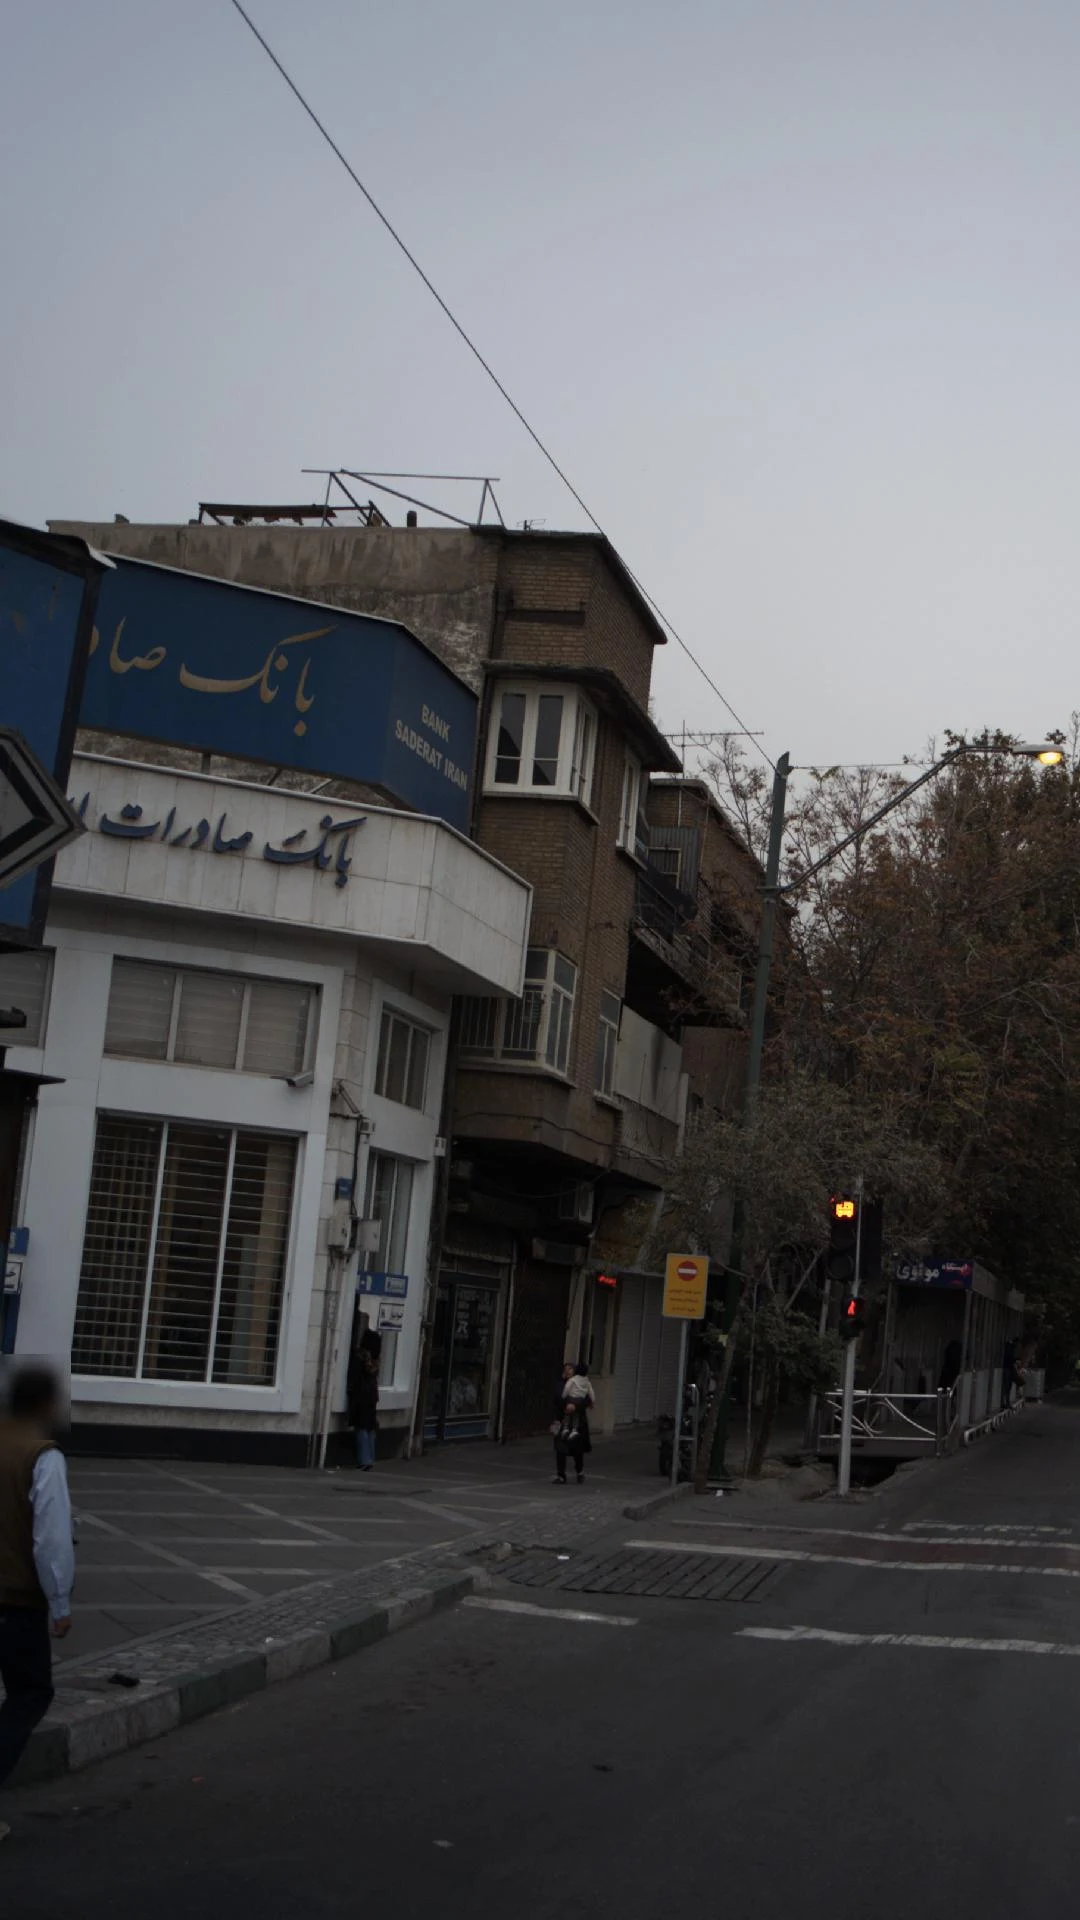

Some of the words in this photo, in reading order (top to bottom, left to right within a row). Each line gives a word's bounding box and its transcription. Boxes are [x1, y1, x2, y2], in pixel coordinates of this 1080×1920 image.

[179, 623, 339, 737] بانک
[395, 719, 443, 771] SADERAT
[444, 758, 468, 793] IRAN
[421, 703, 451, 744] BANK
[100, 802, 254, 853] صادرات
[262, 814, 368, 888] بانک
